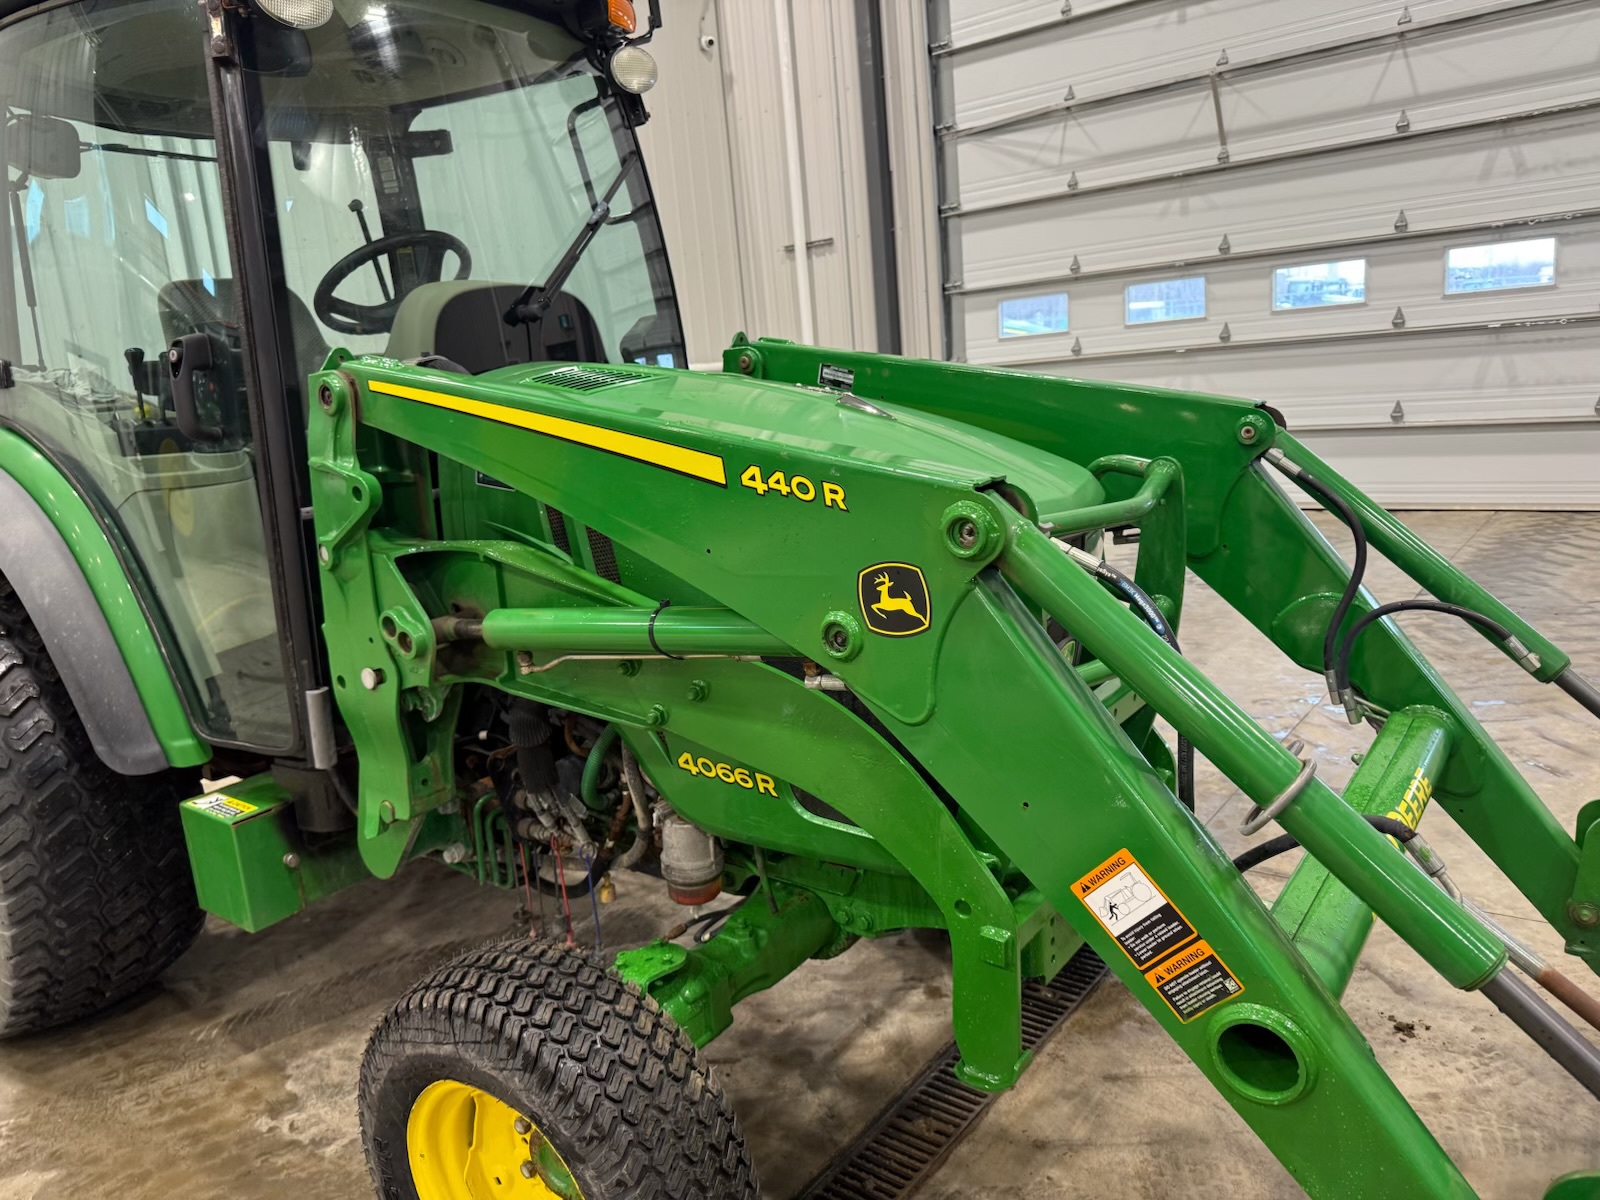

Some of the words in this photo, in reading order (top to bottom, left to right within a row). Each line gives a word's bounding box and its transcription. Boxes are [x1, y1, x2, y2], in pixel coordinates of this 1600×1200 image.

[740, 464, 817, 503] 440
[821, 480, 850, 512] R
[677, 751, 754, 789] 4066
[754, 771, 779, 798] R
[1087, 857, 1126, 886] WARNING
[1163, 948, 1205, 976] WARNING
